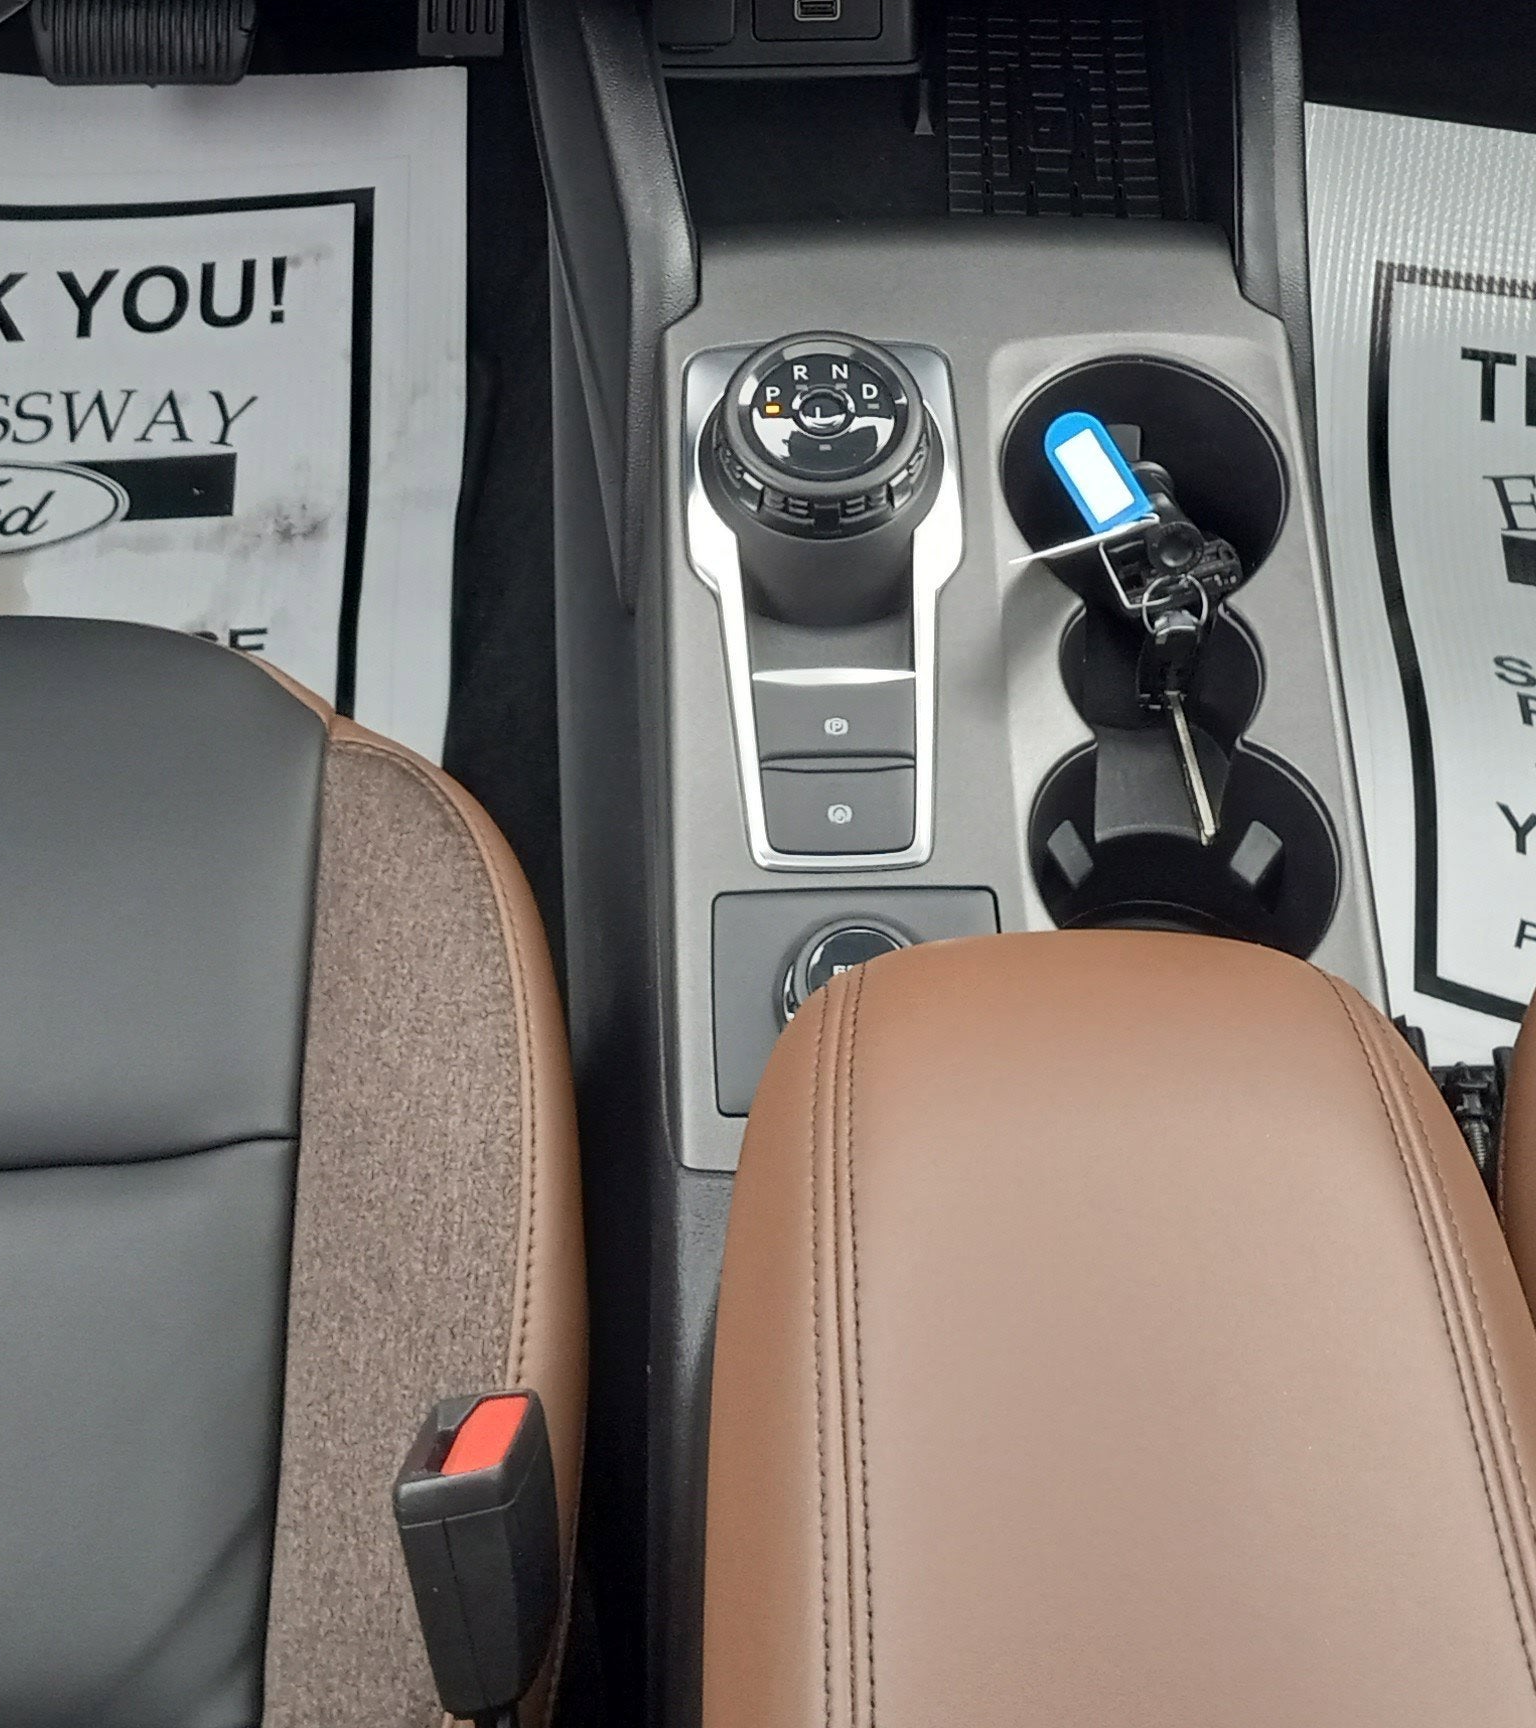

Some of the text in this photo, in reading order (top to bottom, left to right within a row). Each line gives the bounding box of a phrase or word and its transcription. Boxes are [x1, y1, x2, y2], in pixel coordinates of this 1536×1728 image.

[56, 255, 287, 338] YOU!
[792, 364, 808, 380] R
[832, 364, 848, 379] N
[765, 386, 781, 402] P
[862, 384, 878, 400] D
